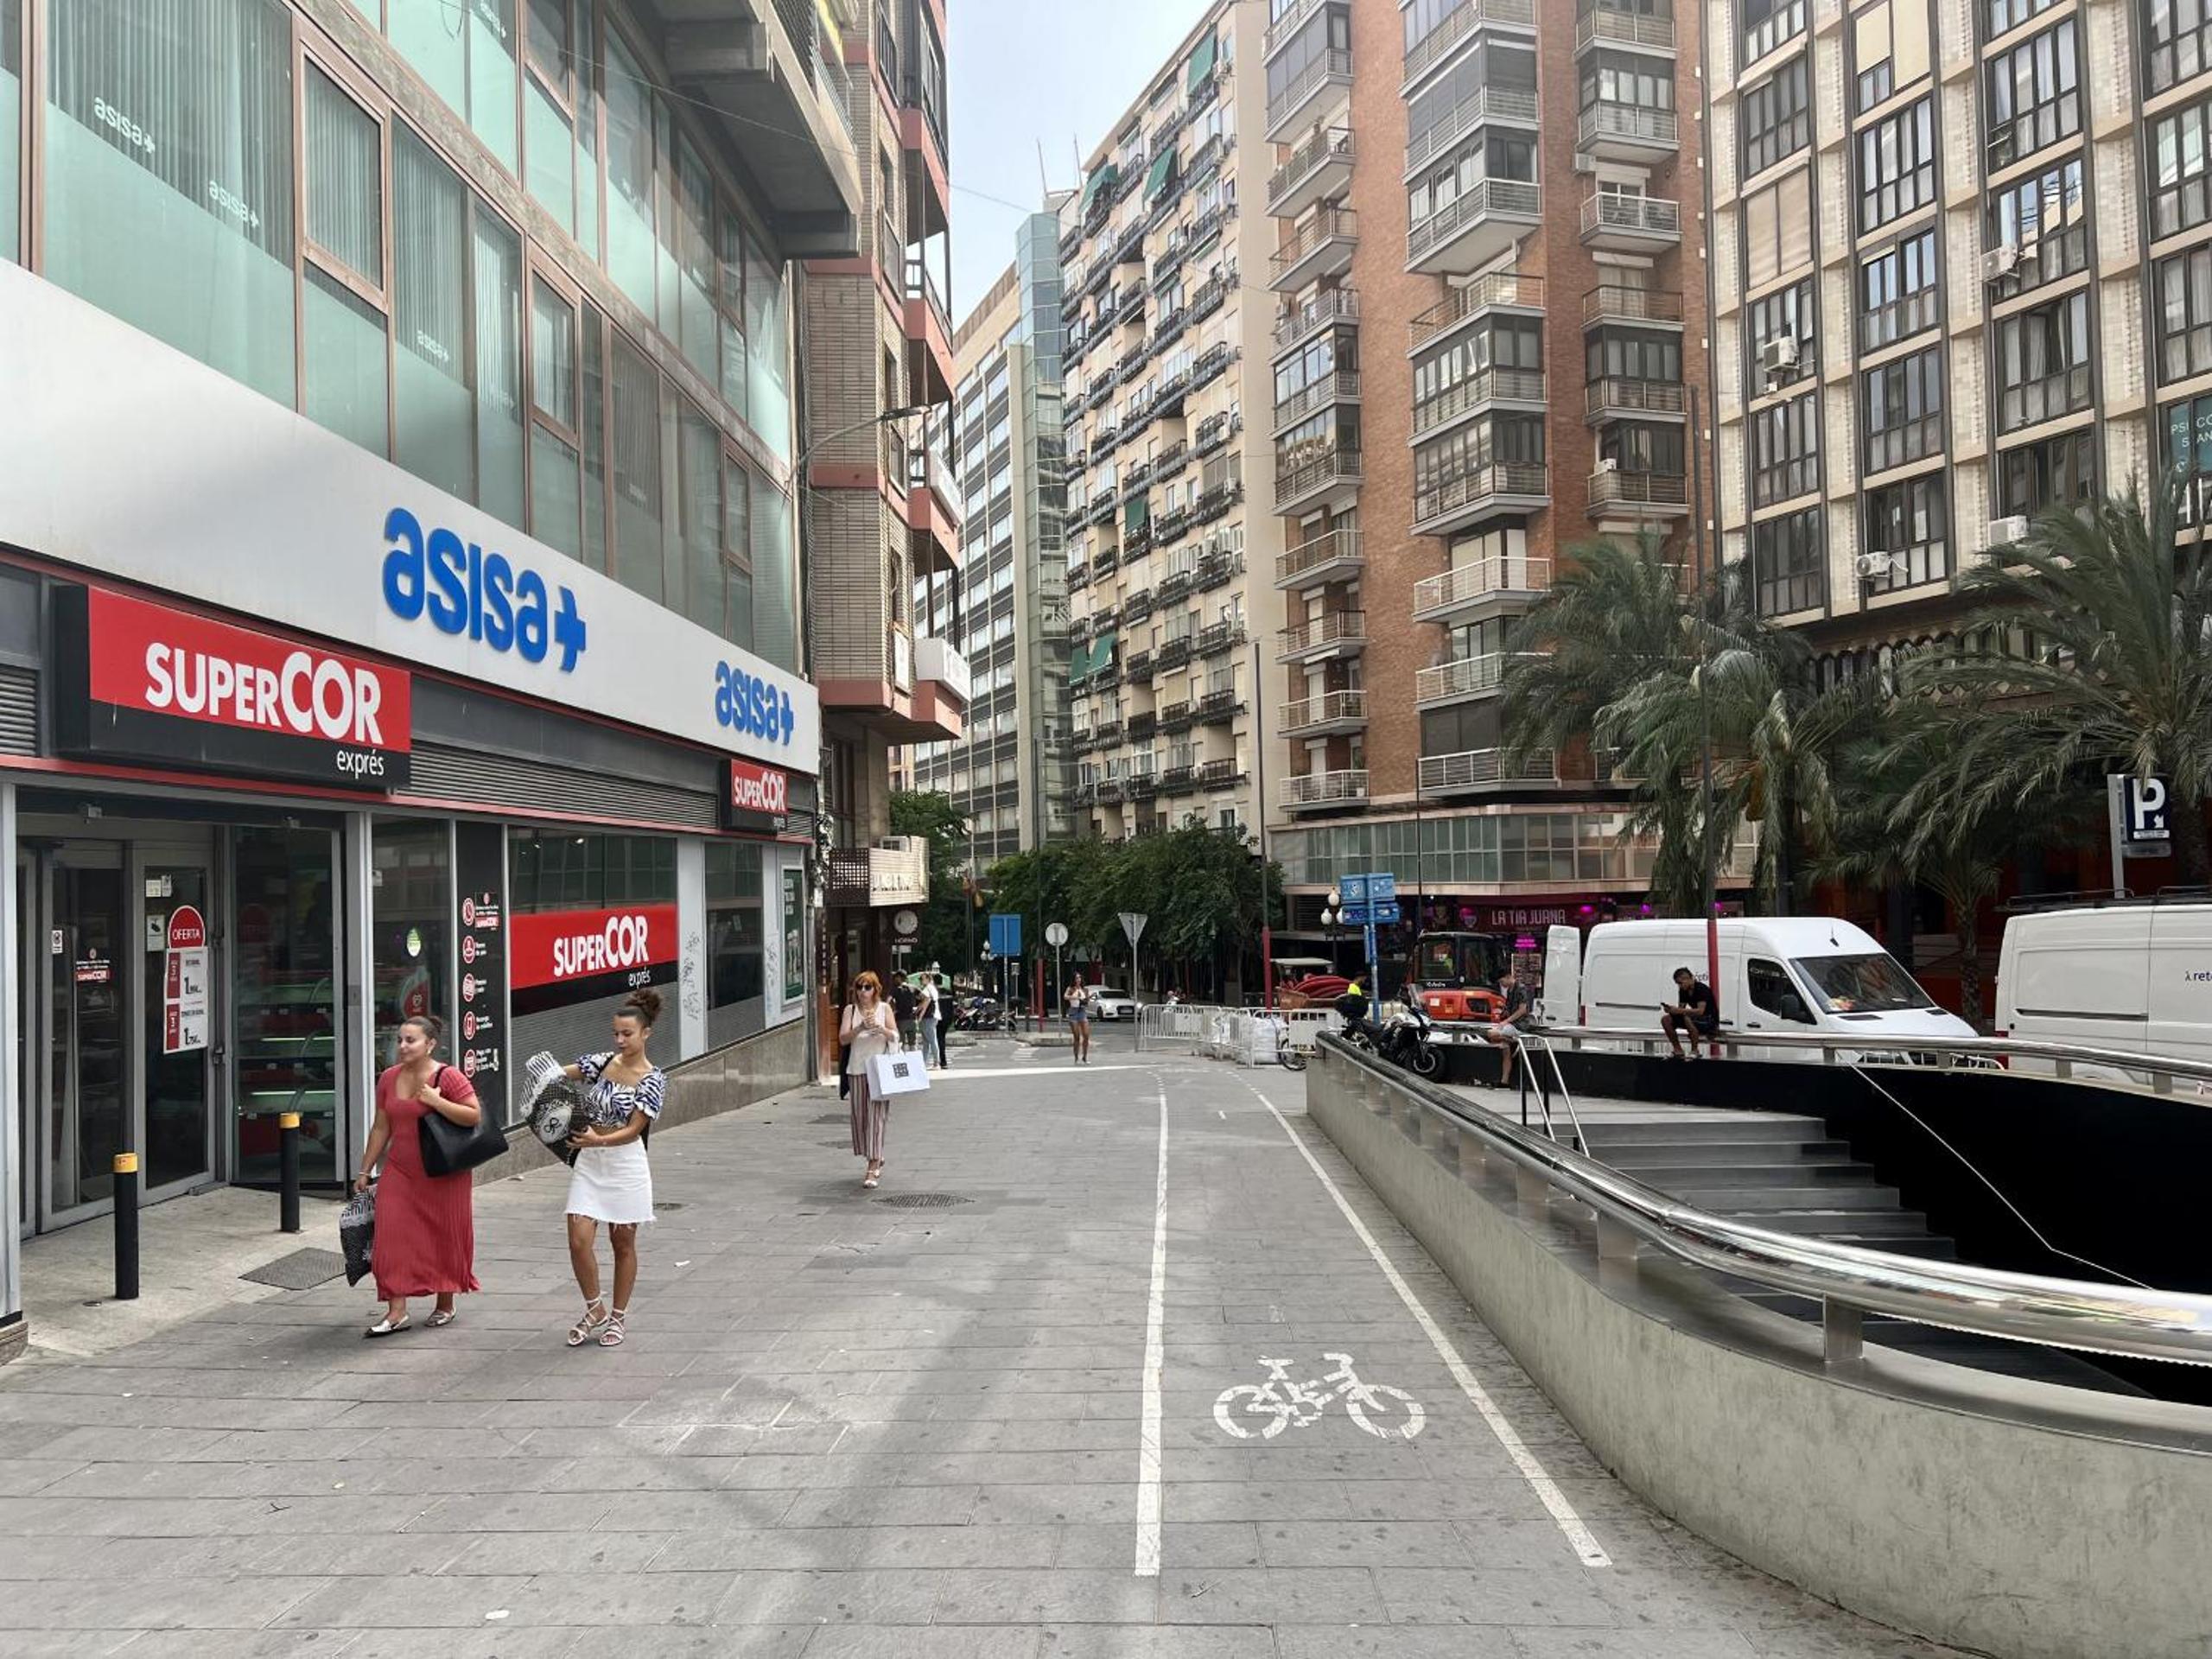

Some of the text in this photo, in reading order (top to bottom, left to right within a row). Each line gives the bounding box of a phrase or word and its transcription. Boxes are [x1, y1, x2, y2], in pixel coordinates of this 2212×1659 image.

[94, 97, 143, 146] asisa
[383, 507, 548, 663] asisa
[145, 642, 384, 745] SUPERCOR
[715, 660, 778, 743] asisa
[337, 749, 385, 779] exprés
[734, 771, 785, 811] SUPERCOR
[554, 915, 650, 977] SUPERCOR
